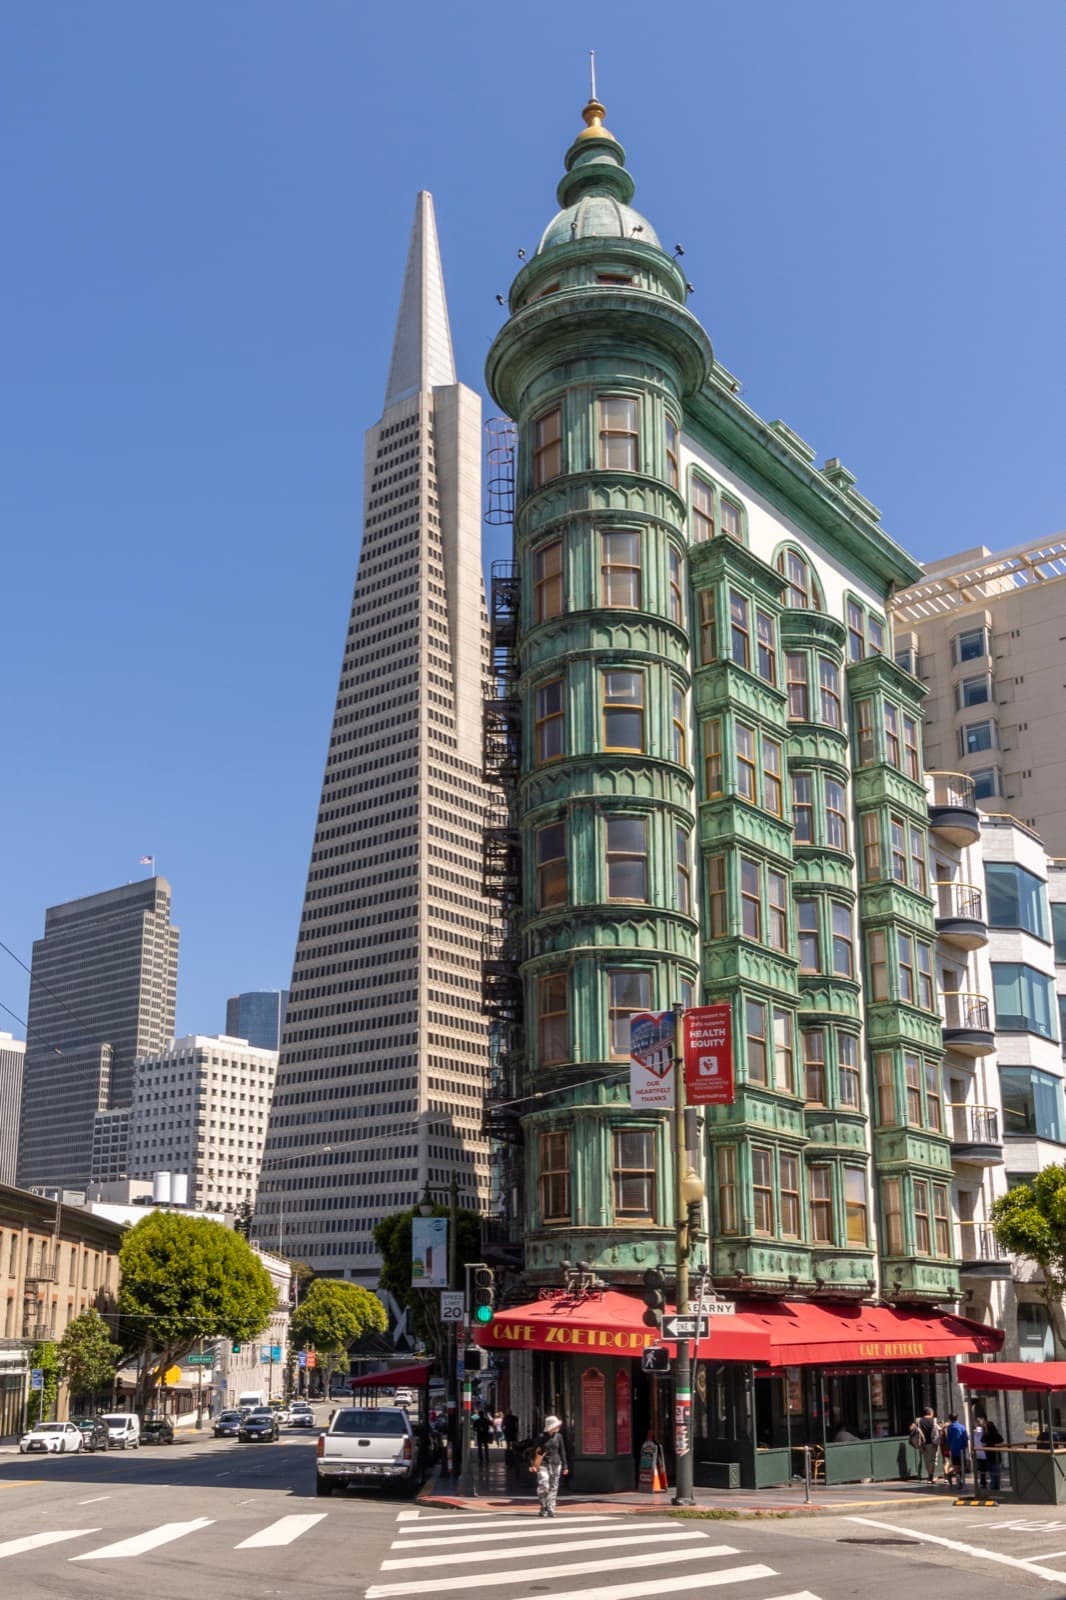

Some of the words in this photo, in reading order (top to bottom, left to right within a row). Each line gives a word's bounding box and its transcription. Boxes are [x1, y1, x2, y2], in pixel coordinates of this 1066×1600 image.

[689, 1028, 726, 1038] HEALTH
[690, 1038, 725, 1048] EQUITY
[635, 1086, 671, 1095] HEARTFELT
[443, 1306, 461, 1318] 20
[687, 1303, 732, 1313] KEARNY
[493, 1324, 535, 1341] CAFE
[544, 1326, 657, 1348] ZOETROPE
